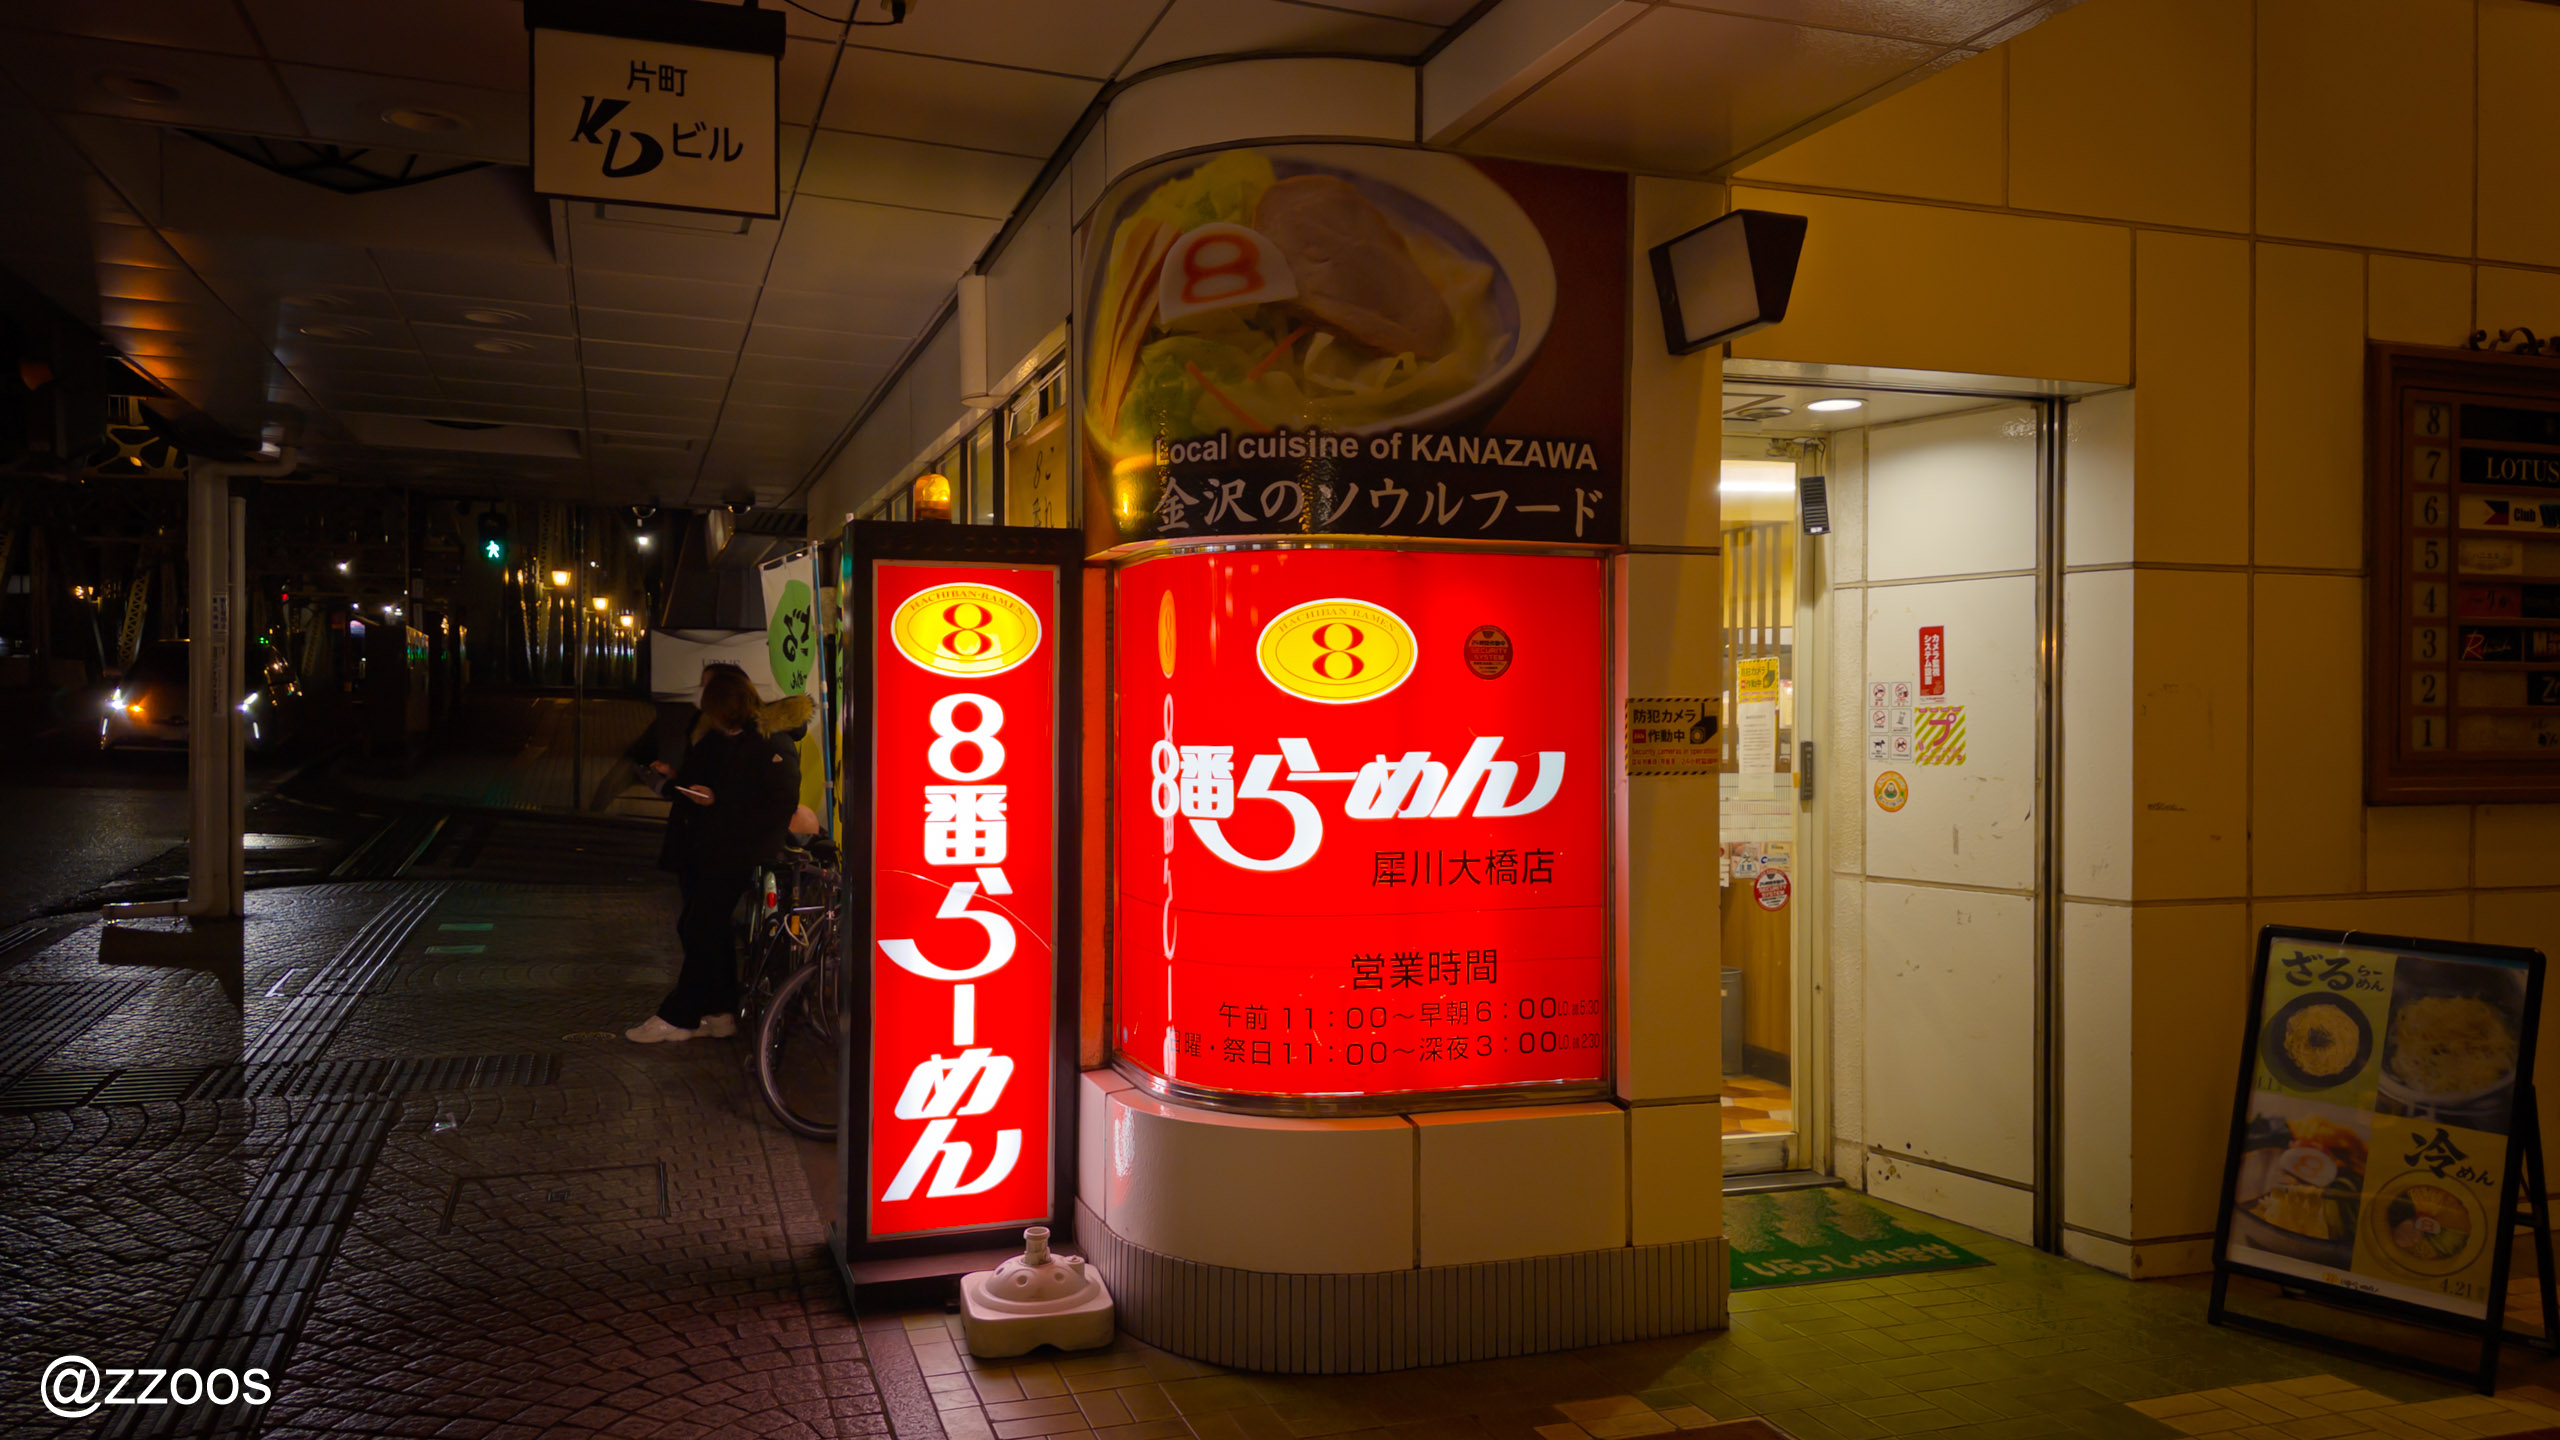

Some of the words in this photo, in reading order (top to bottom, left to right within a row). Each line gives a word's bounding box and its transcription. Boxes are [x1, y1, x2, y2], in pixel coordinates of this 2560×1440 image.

[627, 60, 688, 97] 片町
[672, 121, 744, 163] ビル
[2426, 405, 2441, 435] 8
[1155, 431, 1228, 468] Local
[1237, 429, 1359, 462] cuisine
[1372, 431, 1401, 461] of
[1411, 434, 1599, 471] KANAZAWA
[2426, 450, 2441, 481] 7
[2485, 456, 2560, 484] LOTUS
[1152, 475, 1604, 540] 金沢のソウルフード
[2424, 491, 2438, 525] 6
[2514, 507, 2536, 522] Club
[2424, 540, 2439, 570] 5
[2423, 585, 2438, 614] 4
[942, 602, 994, 657] 8
[1352, 608, 1397, 633] RAMEN
[1312, 622, 1364, 680] 8
[2422, 629, 2437, 660] 3
[2421, 674, 2437, 703] 2
[1633, 708, 1696, 724] 防犯カメラ
[1648, 729, 1685, 743] 作動中
[2422, 720, 2433, 748] 1
[1151, 736, 1567, 872] 8番らーめん
[1371, 848, 1555, 888] 犀川大橋店
[877, 691, 1022, 1202] 8番らーめん
[1350, 949, 1499, 991] 営業時間
[2281, 951, 2355, 992] ざる
